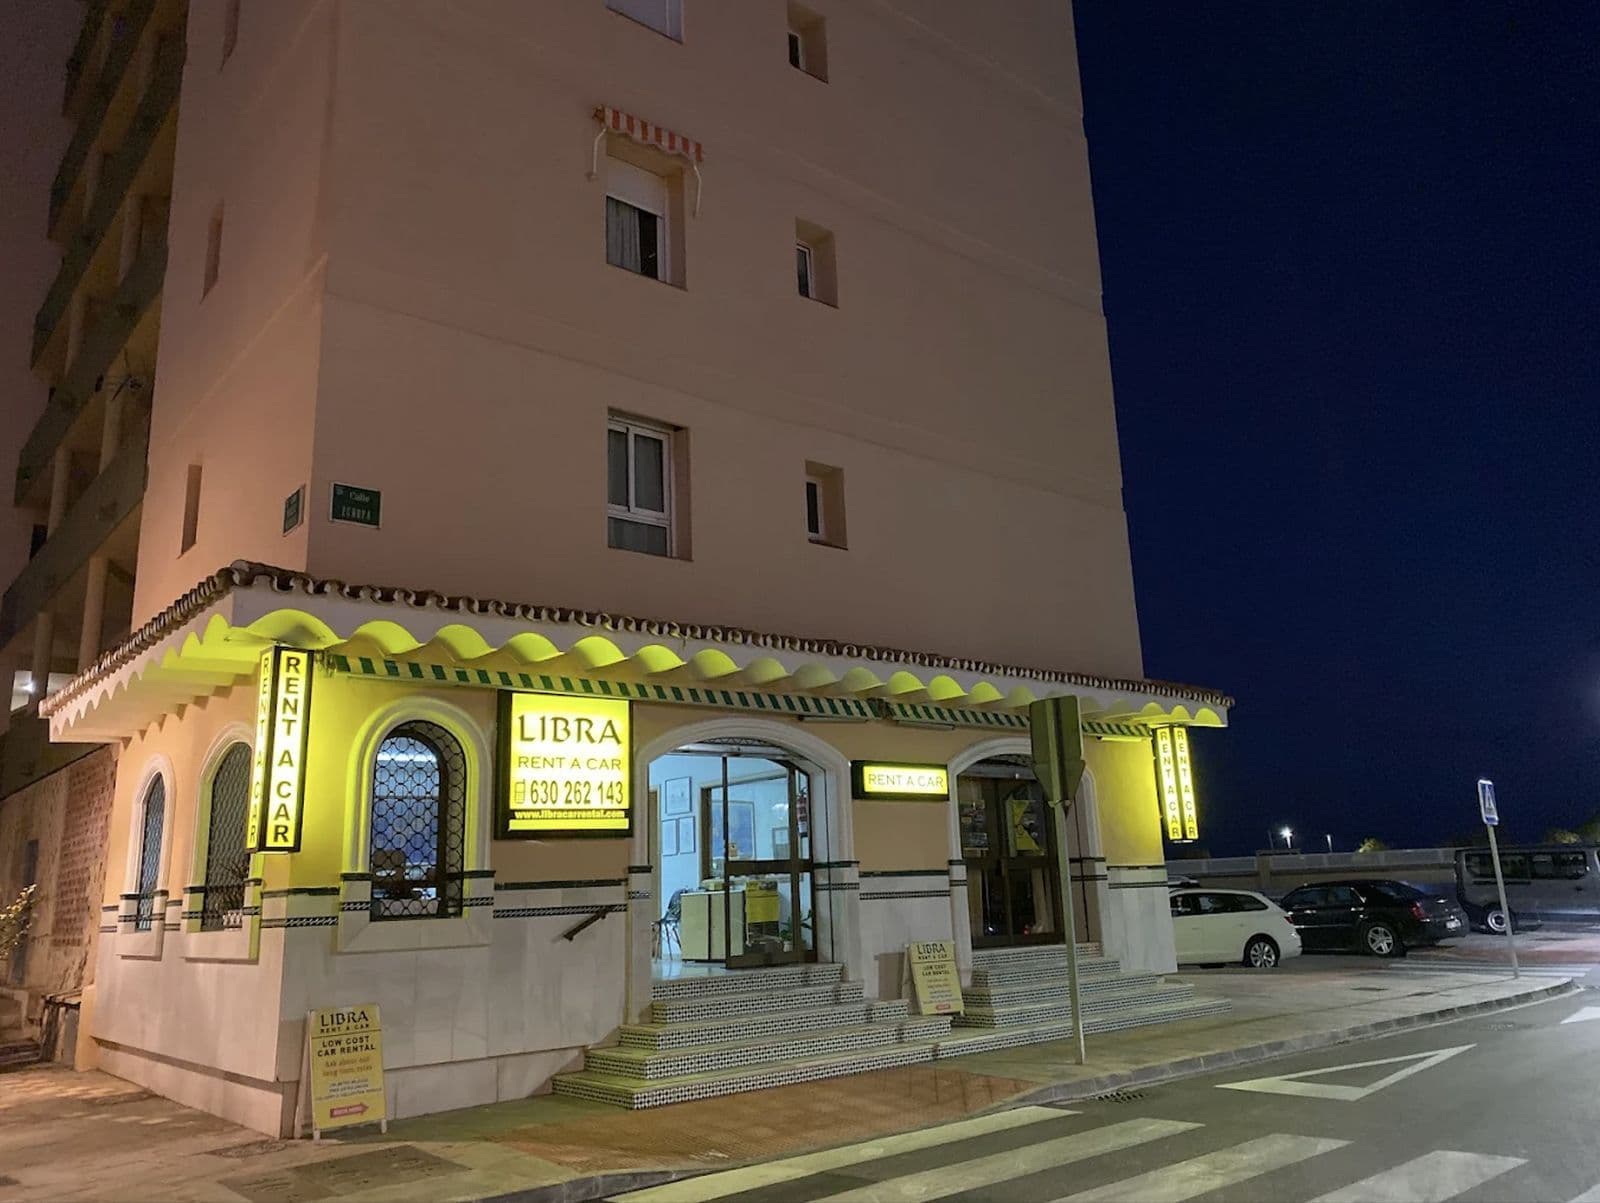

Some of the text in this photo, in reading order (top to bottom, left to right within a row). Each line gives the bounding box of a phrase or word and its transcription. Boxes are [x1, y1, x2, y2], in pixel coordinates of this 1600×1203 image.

[518, 714, 622, 744] LIBRA
[273, 656, 301, 843] RENT A CAR
[518, 756, 622, 770] RENT A CAR
[868, 773, 944, 788] RENT A CAR
[1160, 731, 1180, 837] RENT A CAR
[1177, 730, 1196, 837] RENT A CAR
[530, 780, 624, 804] 630 262 143
[917, 943, 946, 954] LIBRA
[320, 1010, 369, 1027] LIBRA
[322, 1036, 370, 1048] LOW COST
[317, 1045, 376, 1057] CAR RENTAL
